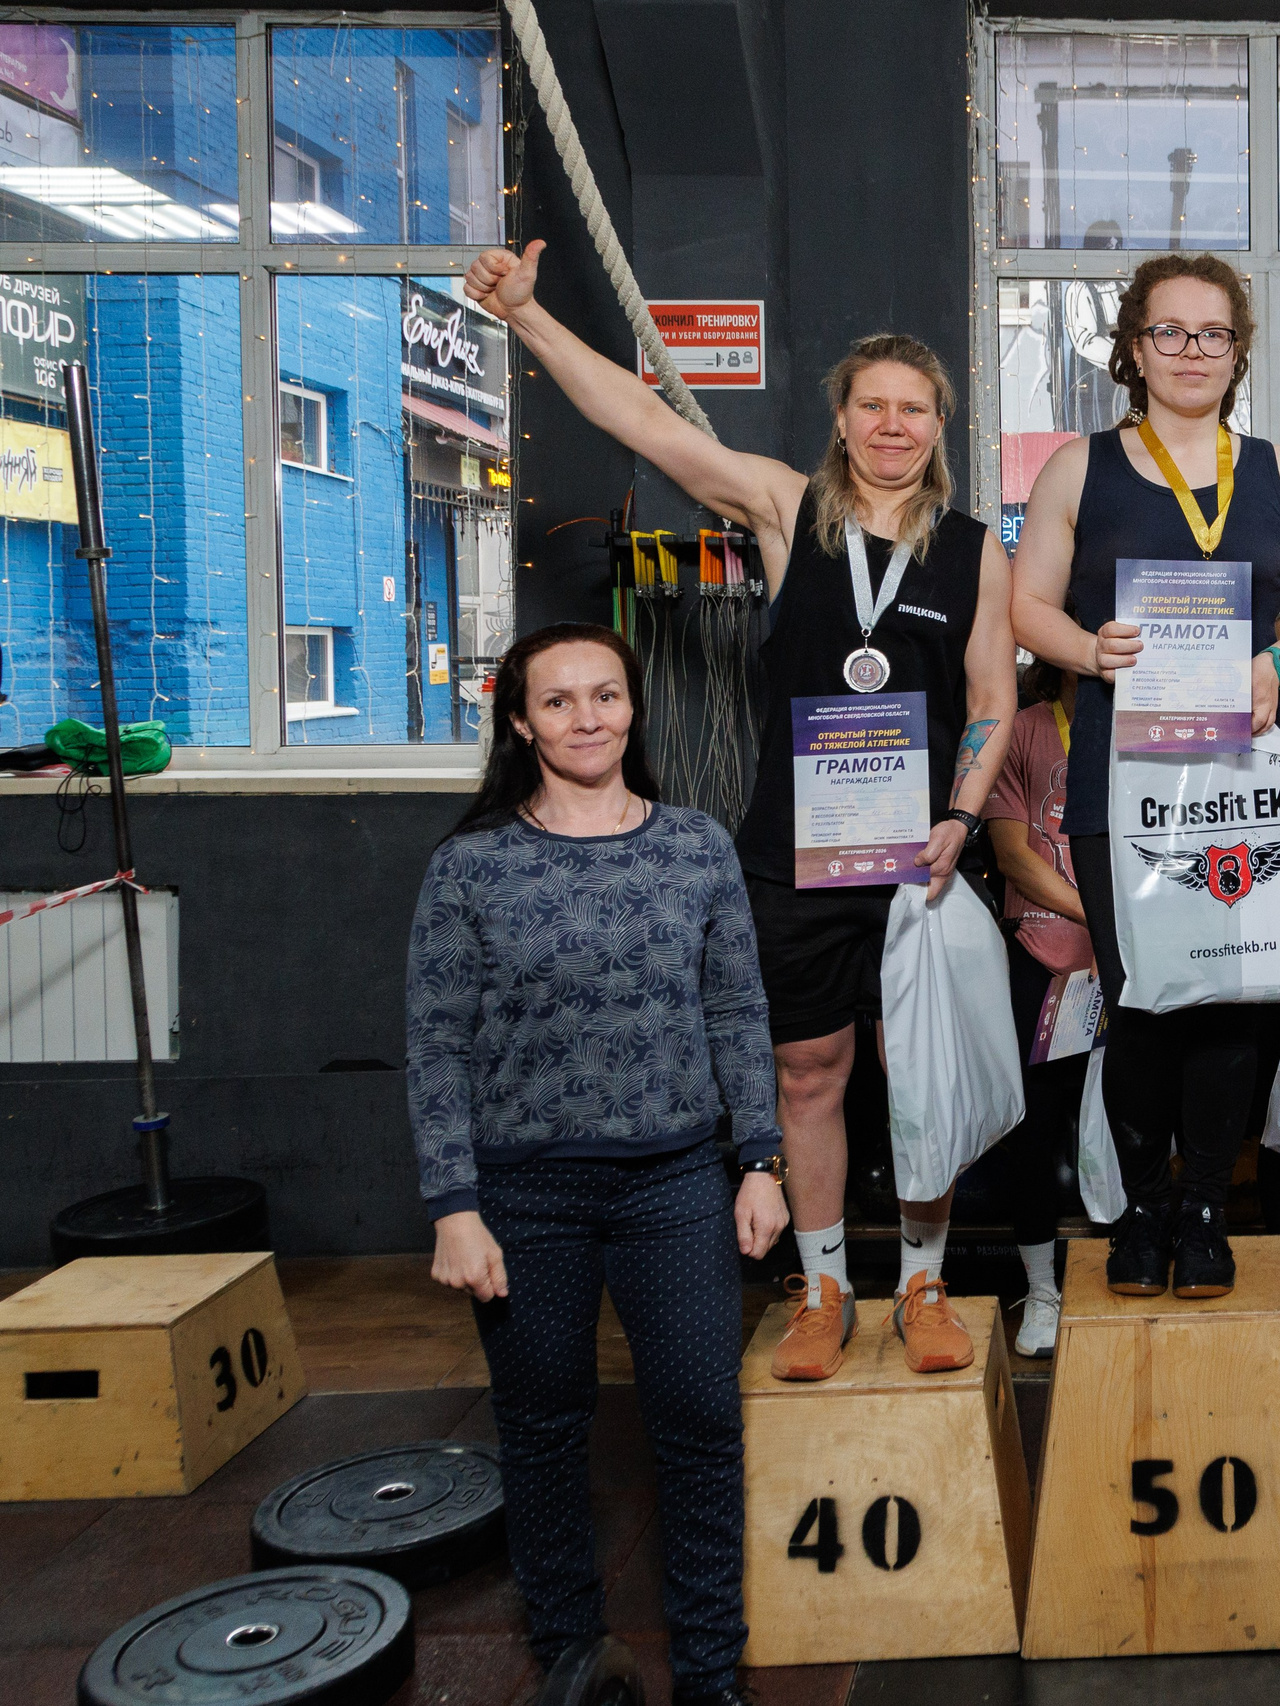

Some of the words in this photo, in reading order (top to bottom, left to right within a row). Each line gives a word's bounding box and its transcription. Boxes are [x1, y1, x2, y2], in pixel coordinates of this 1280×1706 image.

[13, 279, 60, 306] ДРУЗЕЙ
[651, 315, 694, 326] КОНЧИЛ
[696, 314, 758, 327] ТРЕНИРОВКУ
[703, 331, 758, 340] ОБОРУДОВАНИЕ
[33, 356, 58, 371] ОФИС
[35, 368, 56, 388] 106
[1142, 595, 1191, 604] ОТКРЫТЫЙ
[897, 603, 947, 623] ПИЦКОВА
[1148, 606, 1189, 614] ТЯЖЕЛОЙ
[1191, 607, 1234, 615] АТЛЕТИКЕ
[1139, 623, 1229, 640] ГРАМОТА
[810, 742, 822, 750] ПО
[824, 740, 865, 750] ТЯЖЕЛОЙ
[866, 738, 911, 748] АТЛЕТИКЕ
[818, 730, 866, 740] ОТКРЫТЫЙ
[868, 729, 902, 738] ТУРНИР
[815, 756, 906, 775] ГРАМОТА
[830, 776, 892, 785] НАГРАЖДАЕТСЯ
[1141, 791, 1248, 829] CrossFit
[1190, 940, 1277, 959] crossfitekb.ru
[1085, 987, 1103, 1037] АМОТА
[209, 1327, 268, 1412] 30
[1130, 1456, 1258, 1536] 50
[788, 1495, 921, 1574] 40
